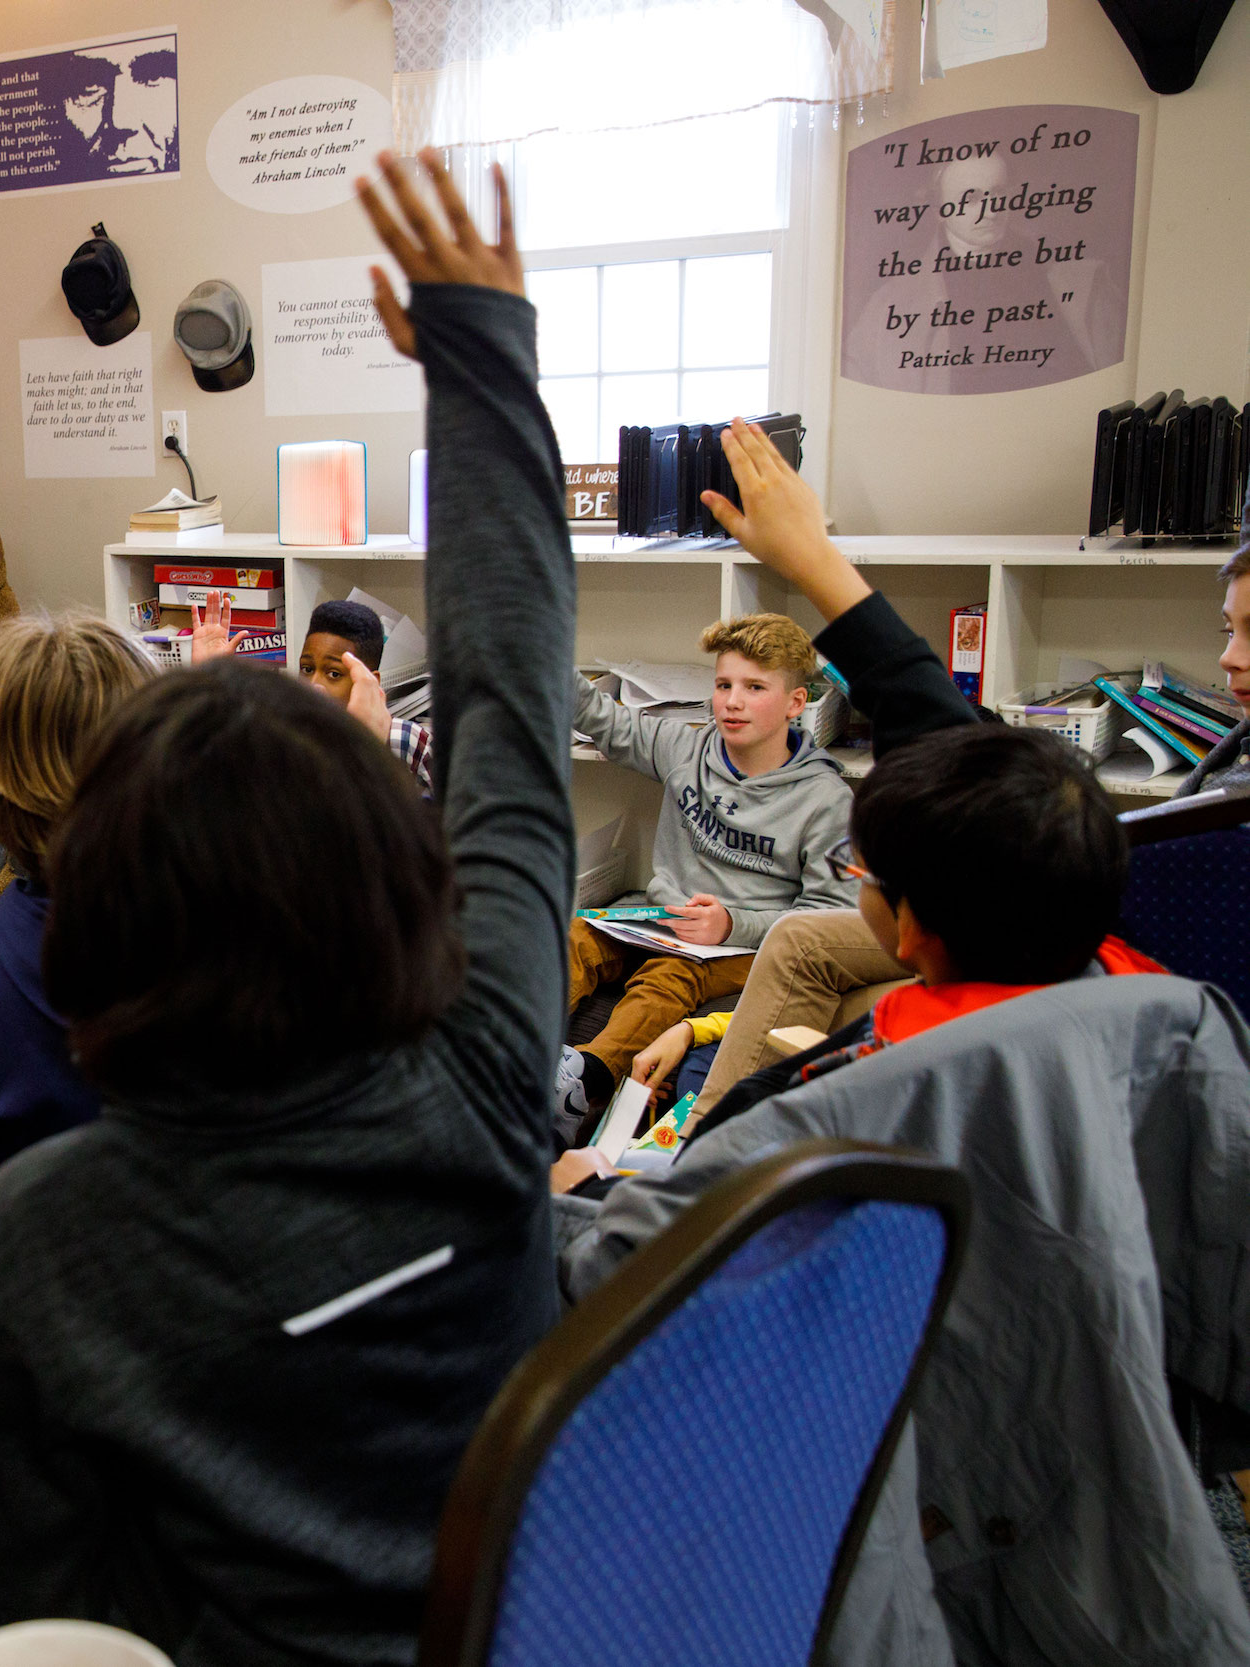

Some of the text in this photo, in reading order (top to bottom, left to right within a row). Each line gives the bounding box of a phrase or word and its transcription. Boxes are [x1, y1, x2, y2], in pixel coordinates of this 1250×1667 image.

[21, 71, 39, 82] that
[247, 98, 357, 121] "Am I not destroying
[250, 118, 354, 143] my enemies when I
[1, 136, 16, 147] the
[916, 139, 1000, 166] know
[1010, 124, 1047, 155] of
[1050, 128, 1092, 150] no
[9, 150, 24, 162] not
[27, 146, 55, 163] perish
[239, 139, 365, 165] make friends of them?"
[11, 165, 27, 176] this
[252, 163, 346, 184] Abraham Lincoln
[874, 182, 1097, 231] way of judging
[878, 238, 1086, 278] the future but
[278, 301, 296, 313] You
[300, 299, 337, 312] cannot
[293, 312, 369, 329] responsibility
[886, 305, 920, 339] by
[930, 301, 975, 327] the
[274, 331, 328, 344] tomorrow
[331, 329, 344, 342] by
[321, 344, 355, 359] today.
[899, 346, 1055, 369] Patrick Henry
[26, 367, 142, 385] Lets have faith that right
[26, 386, 55, 398] makes
[90, 383, 109, 395] and
[111, 384, 121, 394] in
[124, 382, 143, 393] that
[32, 396, 137, 414] faith let us, to the end,
[26, 412, 146, 427] dare to do our duty as we
[53, 426, 118, 439] understand it.
[564, 468, 618, 485] rld where
[573, 491, 610, 518] BE
[678, 785, 776, 858] SANFORD
